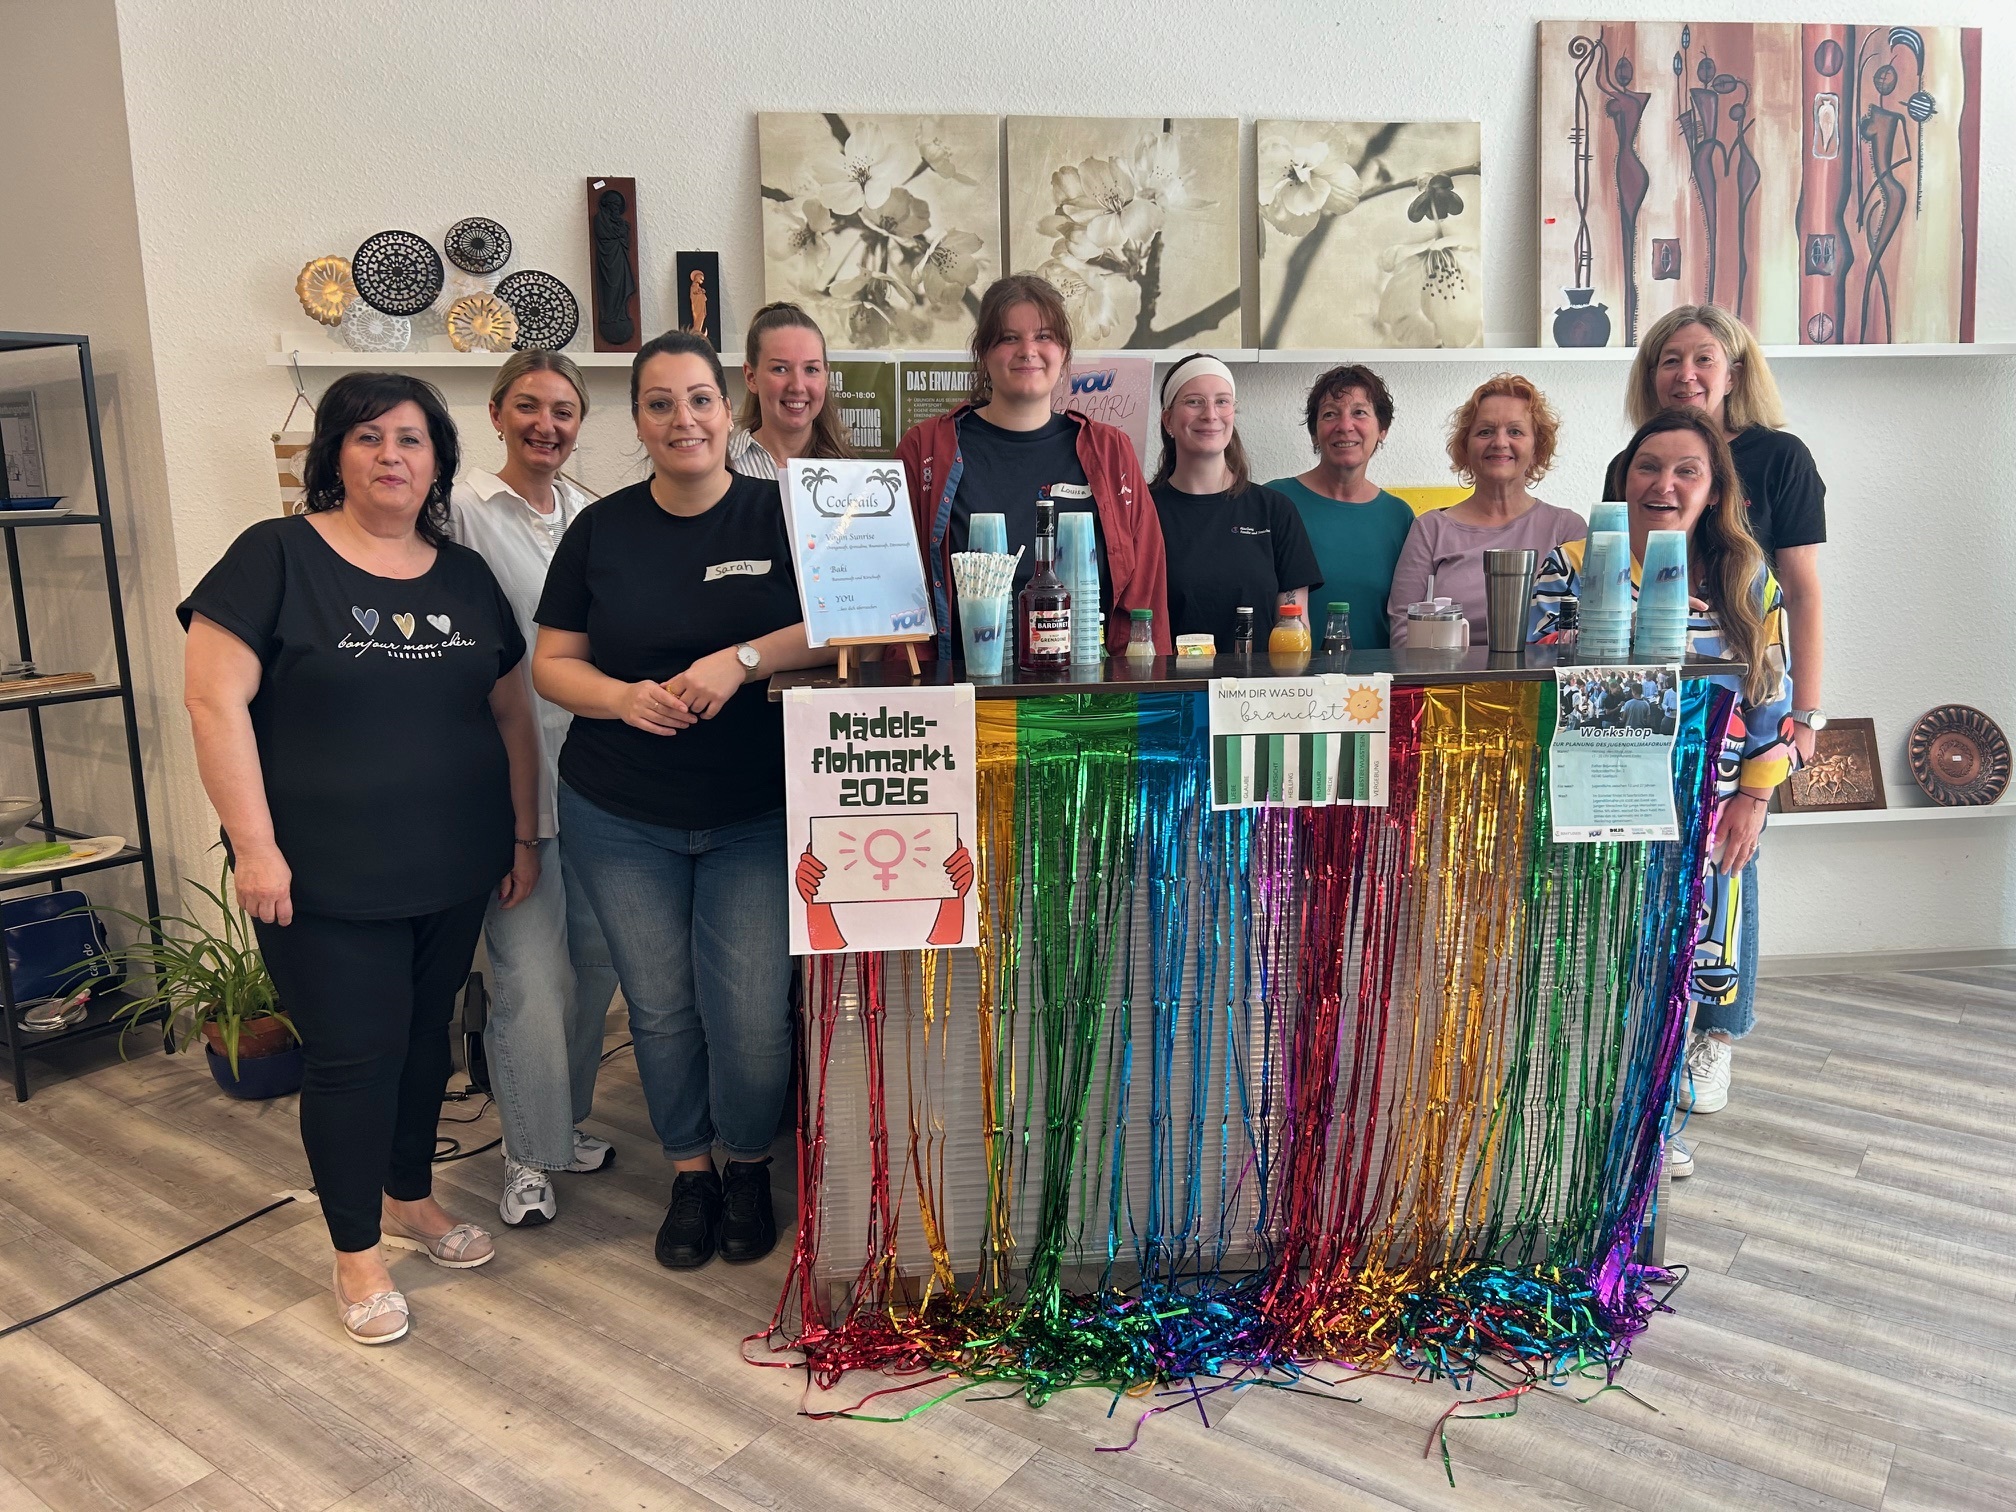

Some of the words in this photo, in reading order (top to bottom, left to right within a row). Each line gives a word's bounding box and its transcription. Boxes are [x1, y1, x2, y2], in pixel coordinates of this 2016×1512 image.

[906, 371, 926, 391] DAS
[826, 493, 879, 508] Cockails
[849, 533, 875, 541] Sunrise
[715, 562, 753, 576] Sarah
[830, 564, 847, 574] Baki
[835, 594, 855, 603] YOU
[337, 633, 400, 658] bonjour
[402, 642, 439, 651] mon
[1218, 689, 1247, 699] NIMM
[1249, 689, 1267, 698] DIR
[1269, 688, 1295, 698] WAS
[1298, 688, 1313, 697] DU
[1240, 700, 1345, 723] brauchst
[829, 706, 938, 741] Mädels-
[1580, 726, 1652, 740] Workshop
[811, 742, 956, 773] flohmarkt
[1358, 734, 1366, 797] SELBSTBEWUSSTSEIN
[839, 777, 929, 806] 2026
